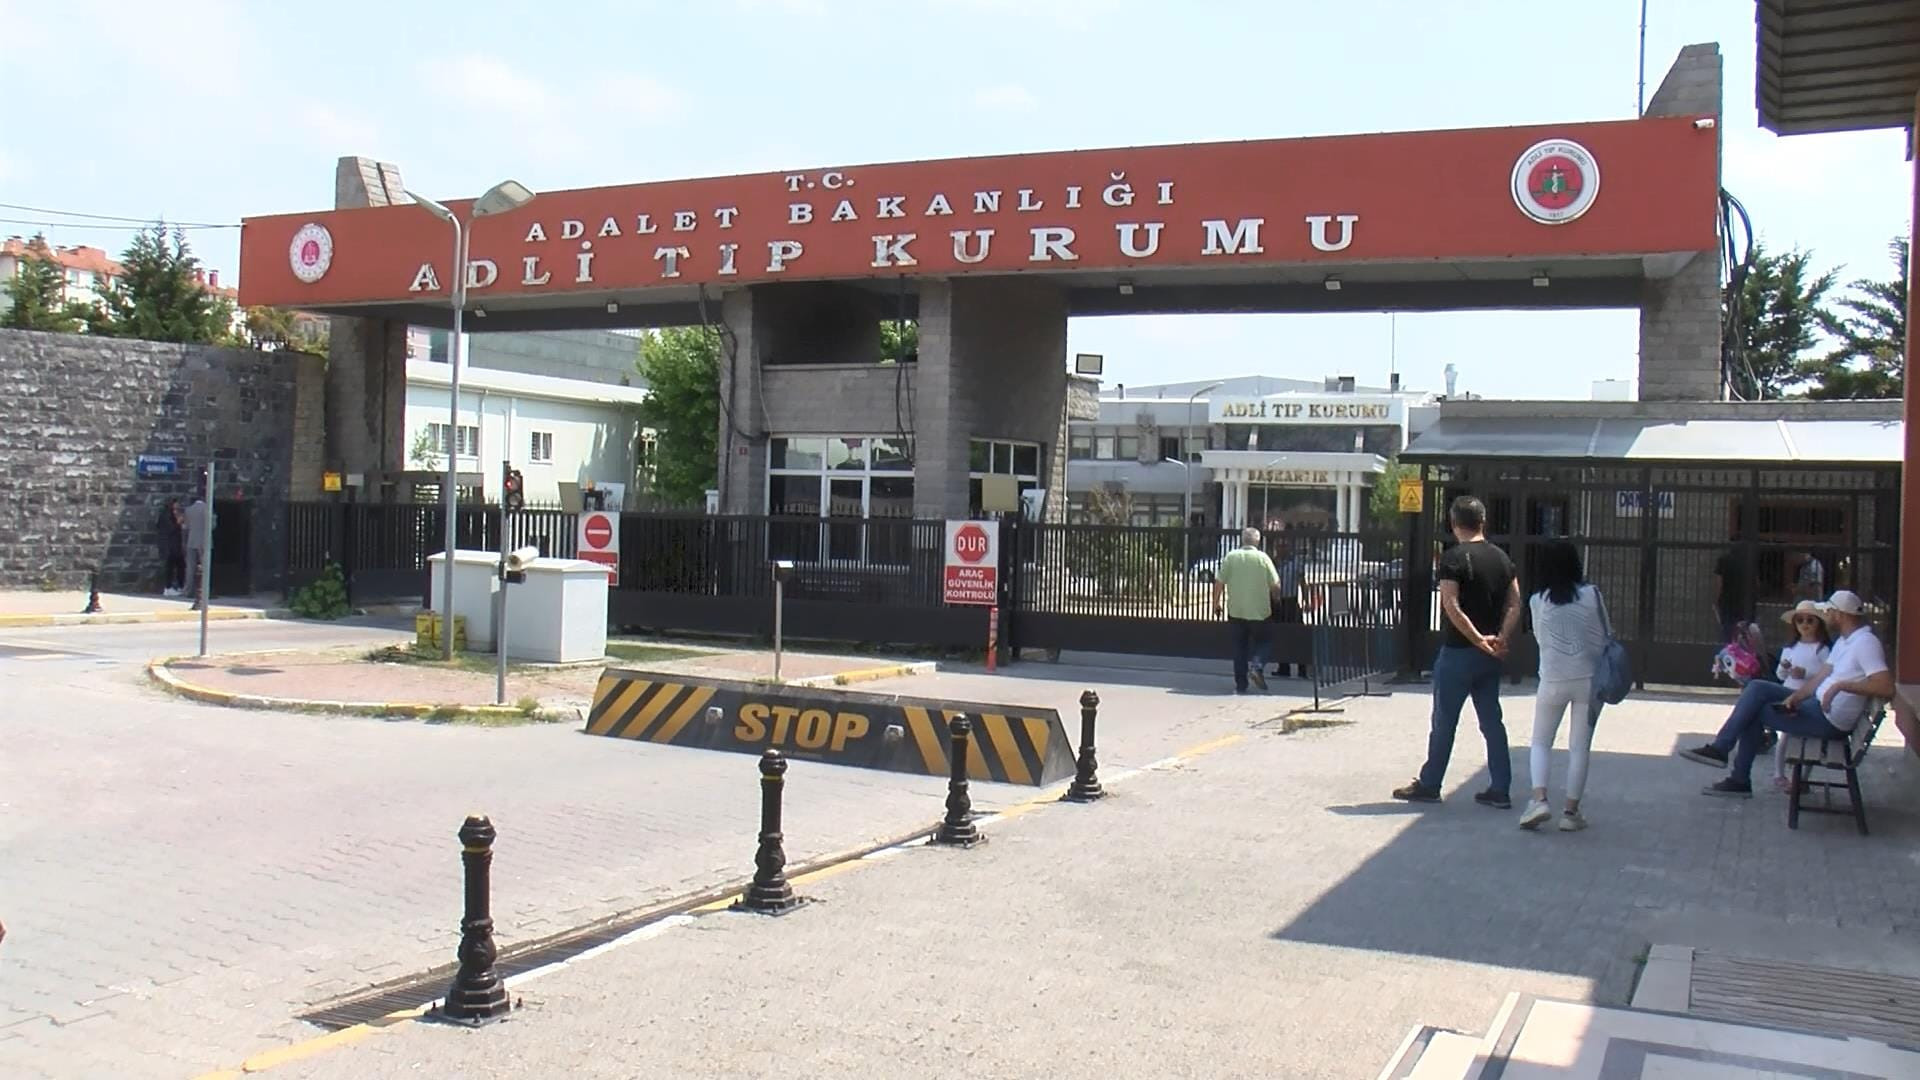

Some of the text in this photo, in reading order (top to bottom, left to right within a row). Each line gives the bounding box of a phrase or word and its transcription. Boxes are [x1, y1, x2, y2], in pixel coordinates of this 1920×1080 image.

[785, 172, 855, 192] T.C.
[525, 171, 1175, 242] ADALET BAKANLIĞI
[409, 215, 1360, 292] ADLİ TIP KURUMU
[1222, 400, 1391, 419] ADLİ TIP KURUMU
[1619, 491, 1673, 510] DANMA
[957, 535, 986, 552] DUR
[958, 568, 984, 579] ARAÇ
[947, 578, 994, 589] GÜVENLİK
[946, 588, 995, 600] KONTROLÜ
[734, 702, 870, 752] STOP
